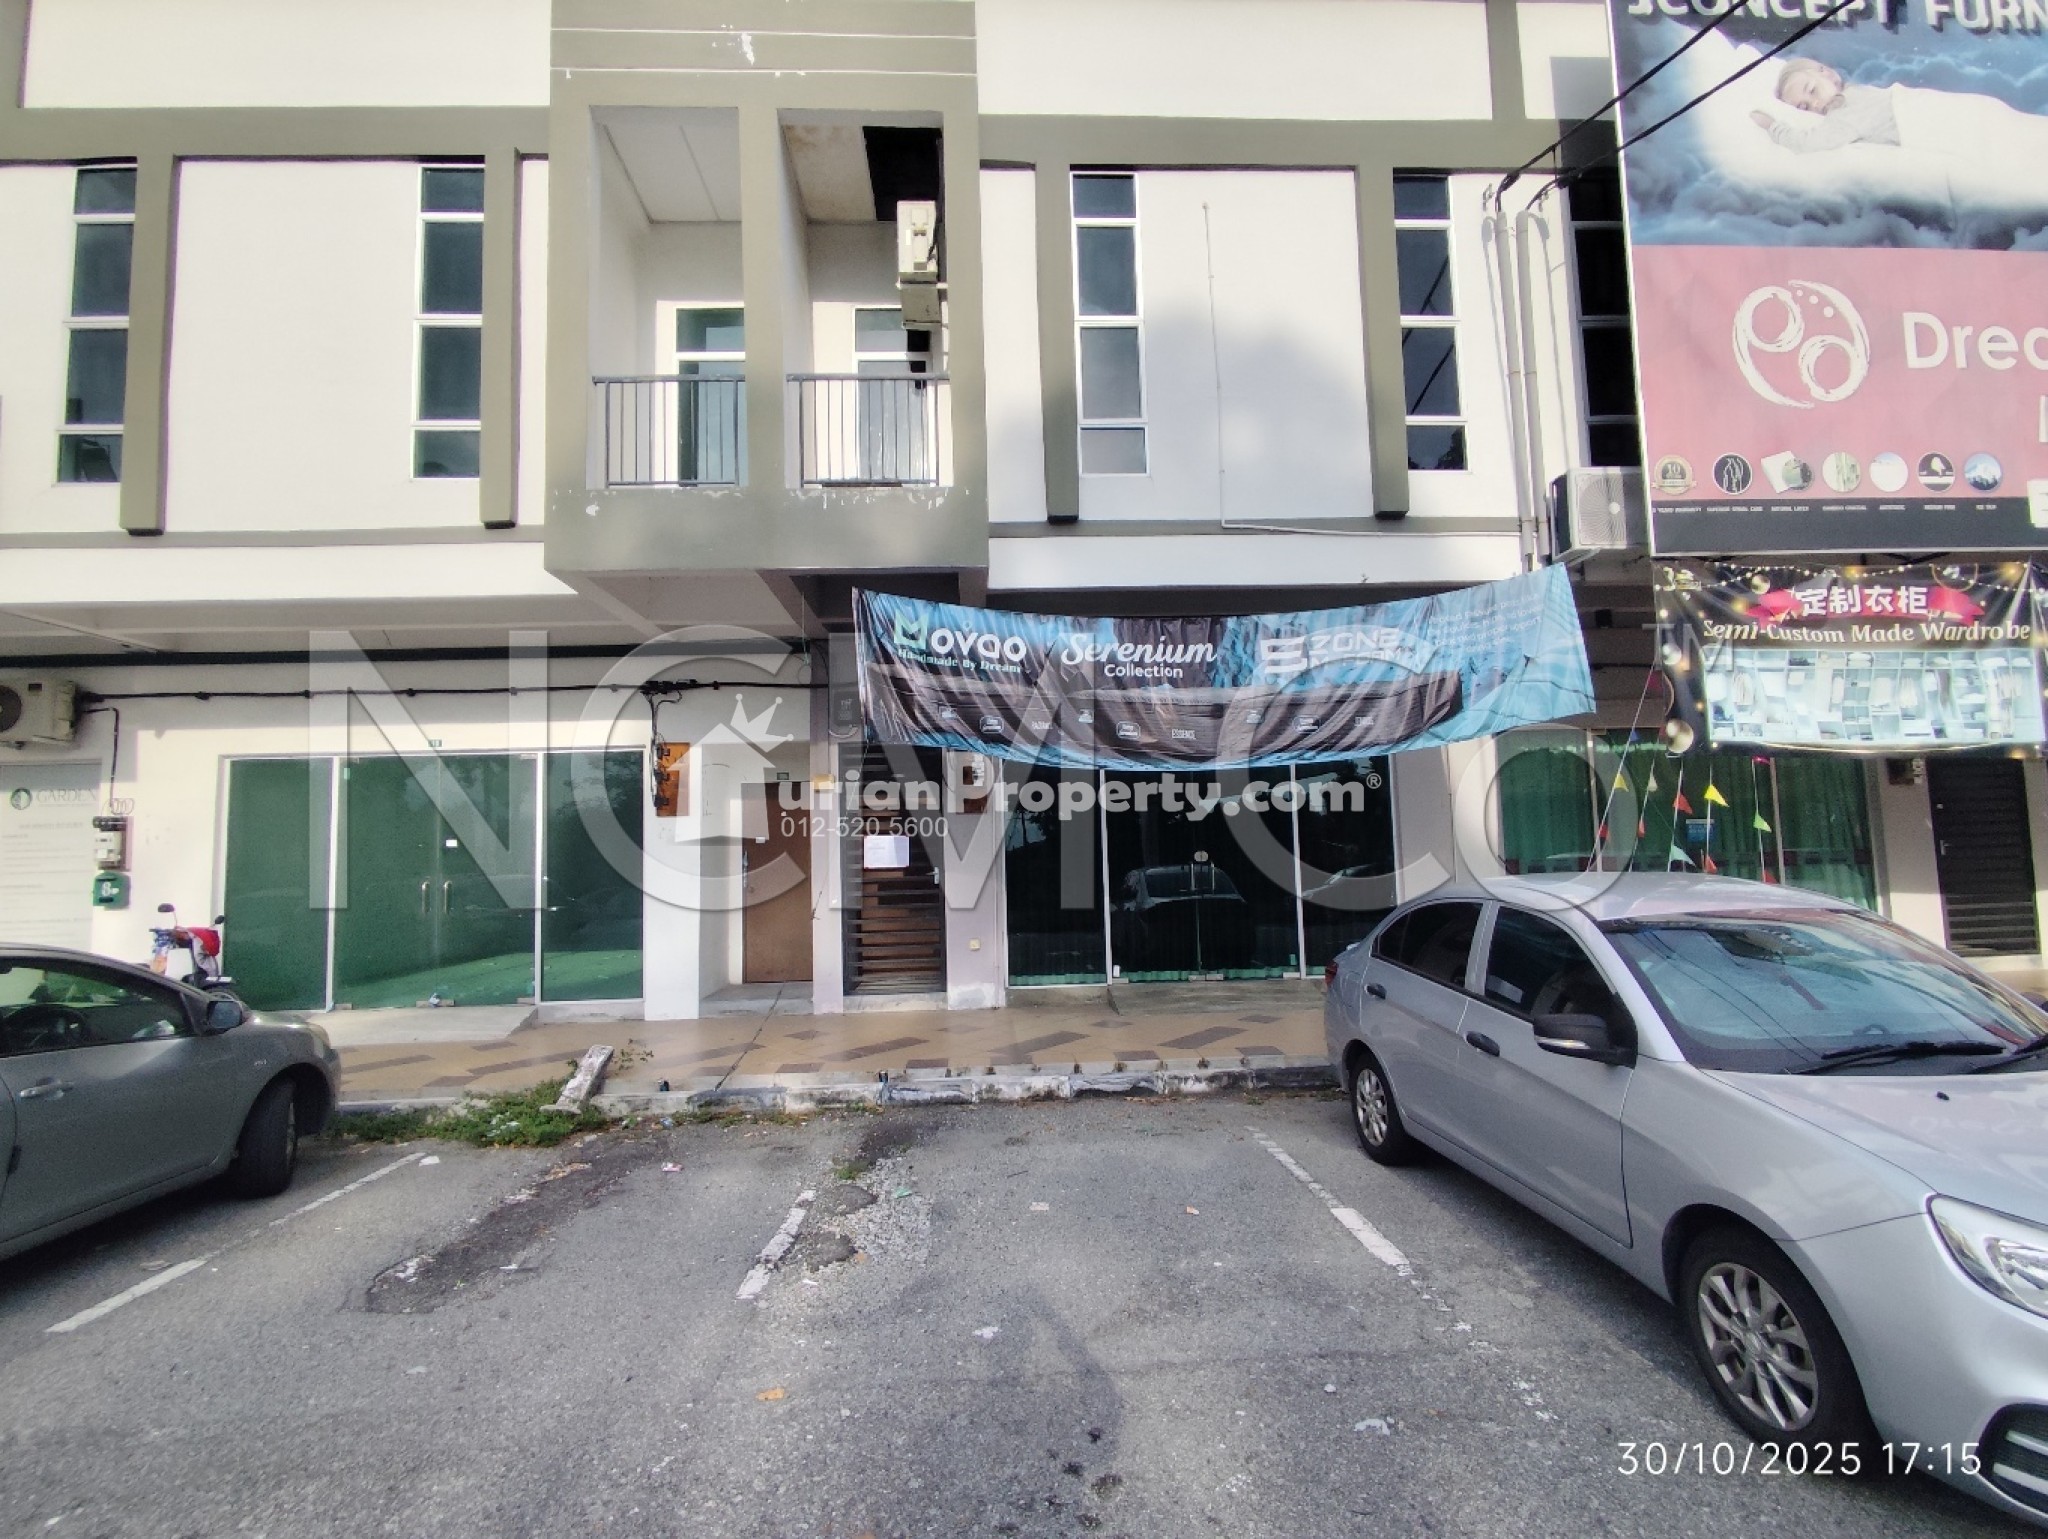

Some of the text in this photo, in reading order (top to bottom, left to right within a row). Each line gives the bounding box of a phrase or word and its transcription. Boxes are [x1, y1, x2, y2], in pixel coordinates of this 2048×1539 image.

[1798, 584, 1929, 617] 定制衣柜
[1309, 627, 1400, 655] ZONE
[1703, 620, 2030, 644] Semi-Custom Made Wardrobe
[899, 648, 1021, 673] Handmade By Dream
[1061, 633, 1218, 665] Serenium
[1104, 663, 1184, 679] Collection
